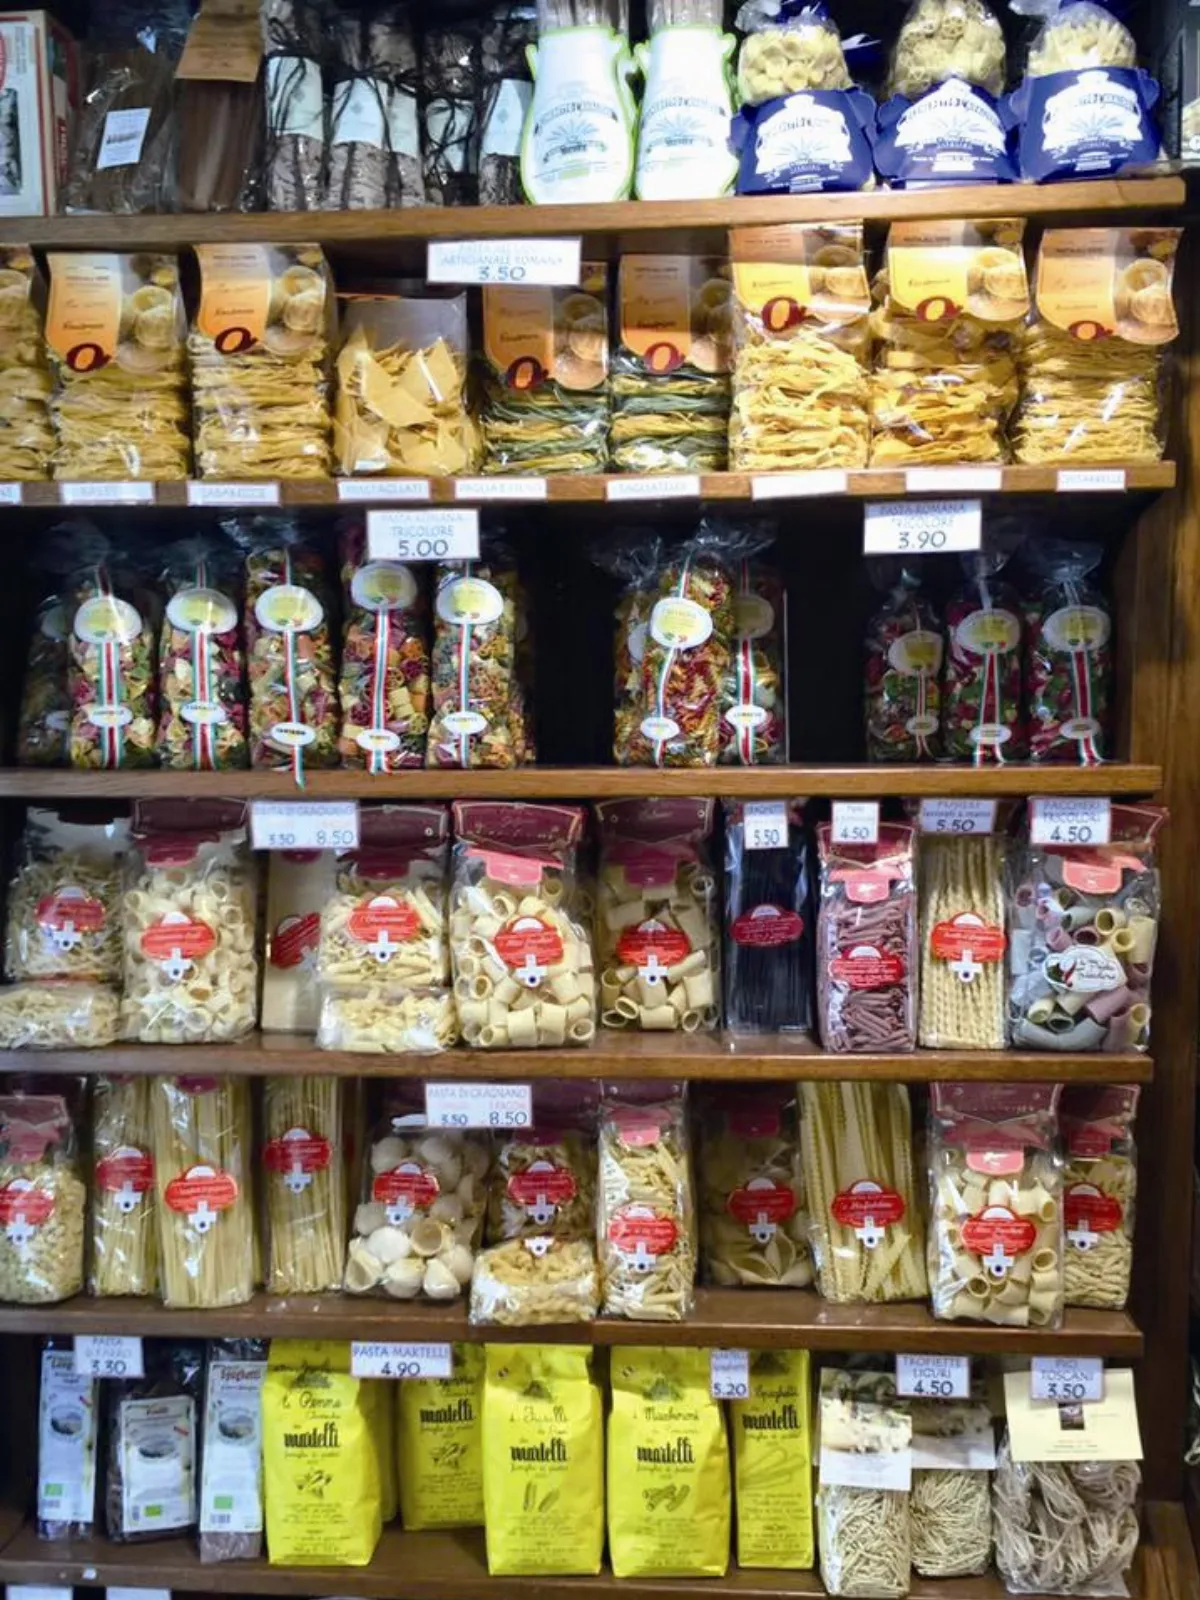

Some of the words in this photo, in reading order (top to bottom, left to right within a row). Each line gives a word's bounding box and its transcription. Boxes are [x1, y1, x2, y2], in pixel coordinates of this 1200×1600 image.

[479, 266, 526, 281] 3.50
[398, 539, 449, 557] 5.00
[898, 531, 947, 549] 3.90
[840, 826, 870, 840] 4.50
[936, 818, 976, 833] 5.50
[1050, 825, 1093, 842] 4.50
[316, 830, 354, 845] 8.50
[753, 828, 780, 846] 5.50
[489, 1110, 528, 1126] 8.50
[353, 1345, 389, 1357] PASTA
[393, 1345, 449, 1358] MARTELLI
[380, 1361, 421, 1376] 4.90
[713, 1383, 747, 1396] 5.20
[913, 1379, 954, 1396] 4.50
[1047, 1382, 1086, 1399] 3.50
[419, 1398, 476, 1424] martelli
[742, 1405, 802, 1430] martelli
[283, 1421, 341, 1448] martelli
[510, 1436, 569, 1462] martelli
[636, 1436, 697, 1464] martelli
